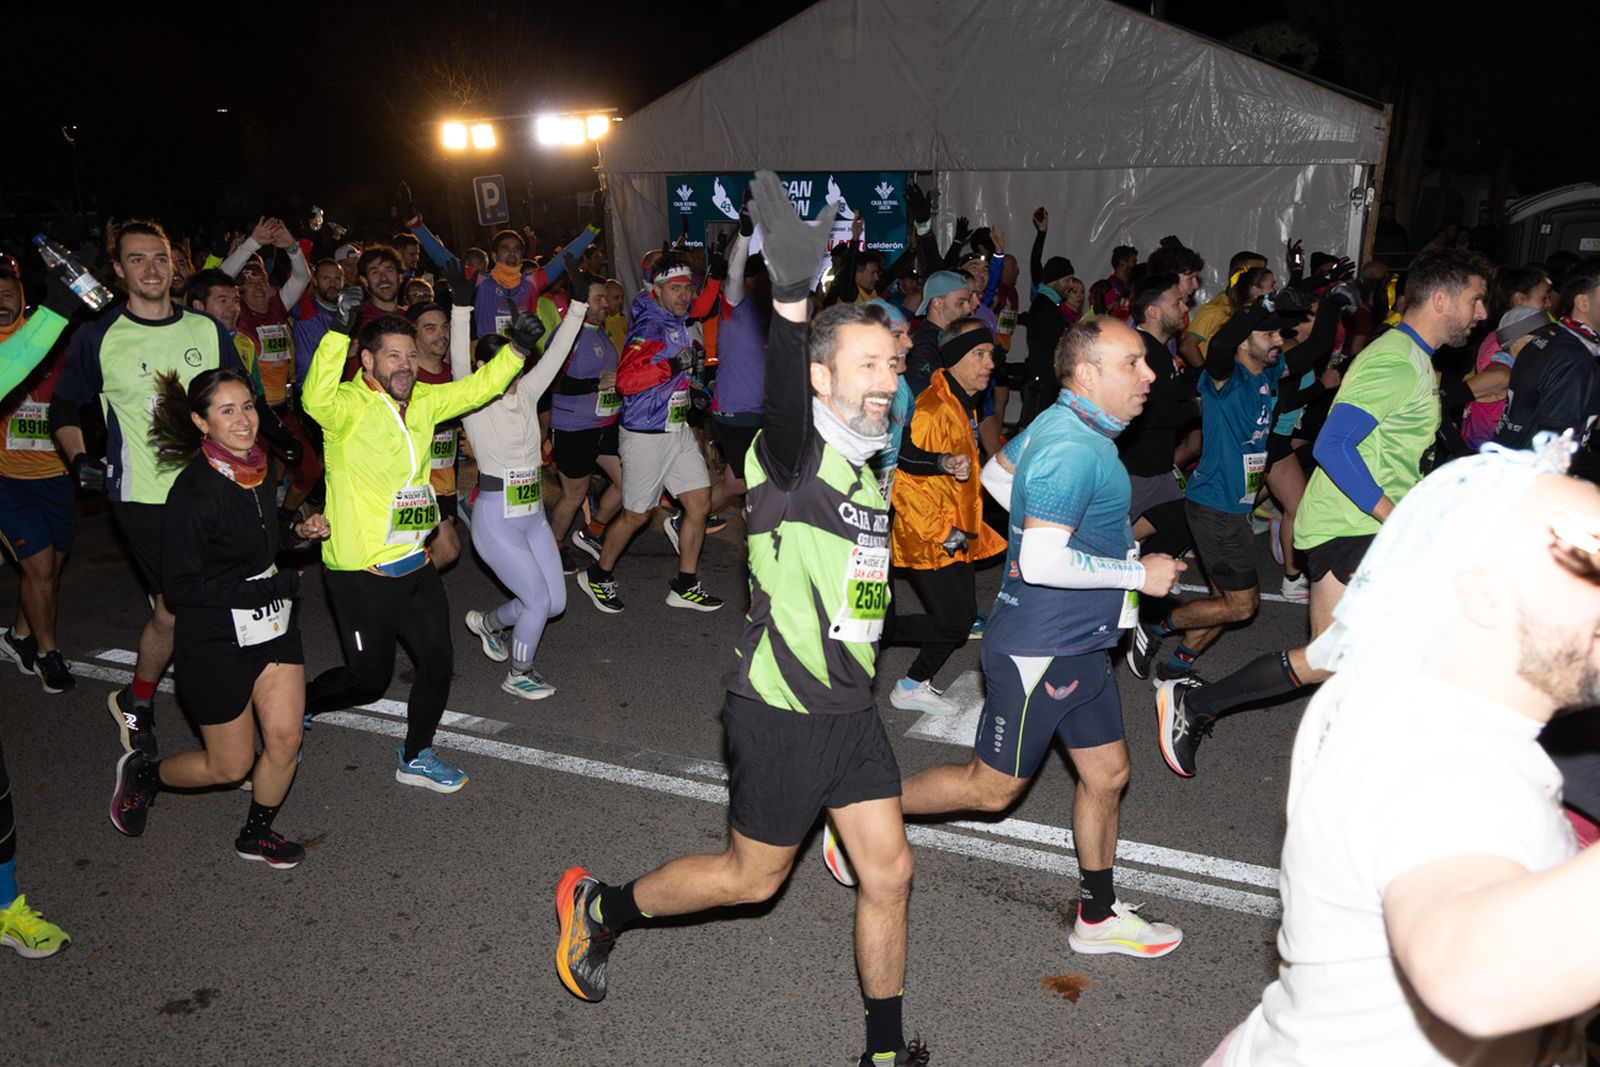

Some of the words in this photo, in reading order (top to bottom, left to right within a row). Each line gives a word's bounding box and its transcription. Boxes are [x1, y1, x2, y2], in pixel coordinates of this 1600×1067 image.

[481, 182, 500, 208] P
[867, 241, 904, 250] calderón
[398, 504, 436, 526] 12619
